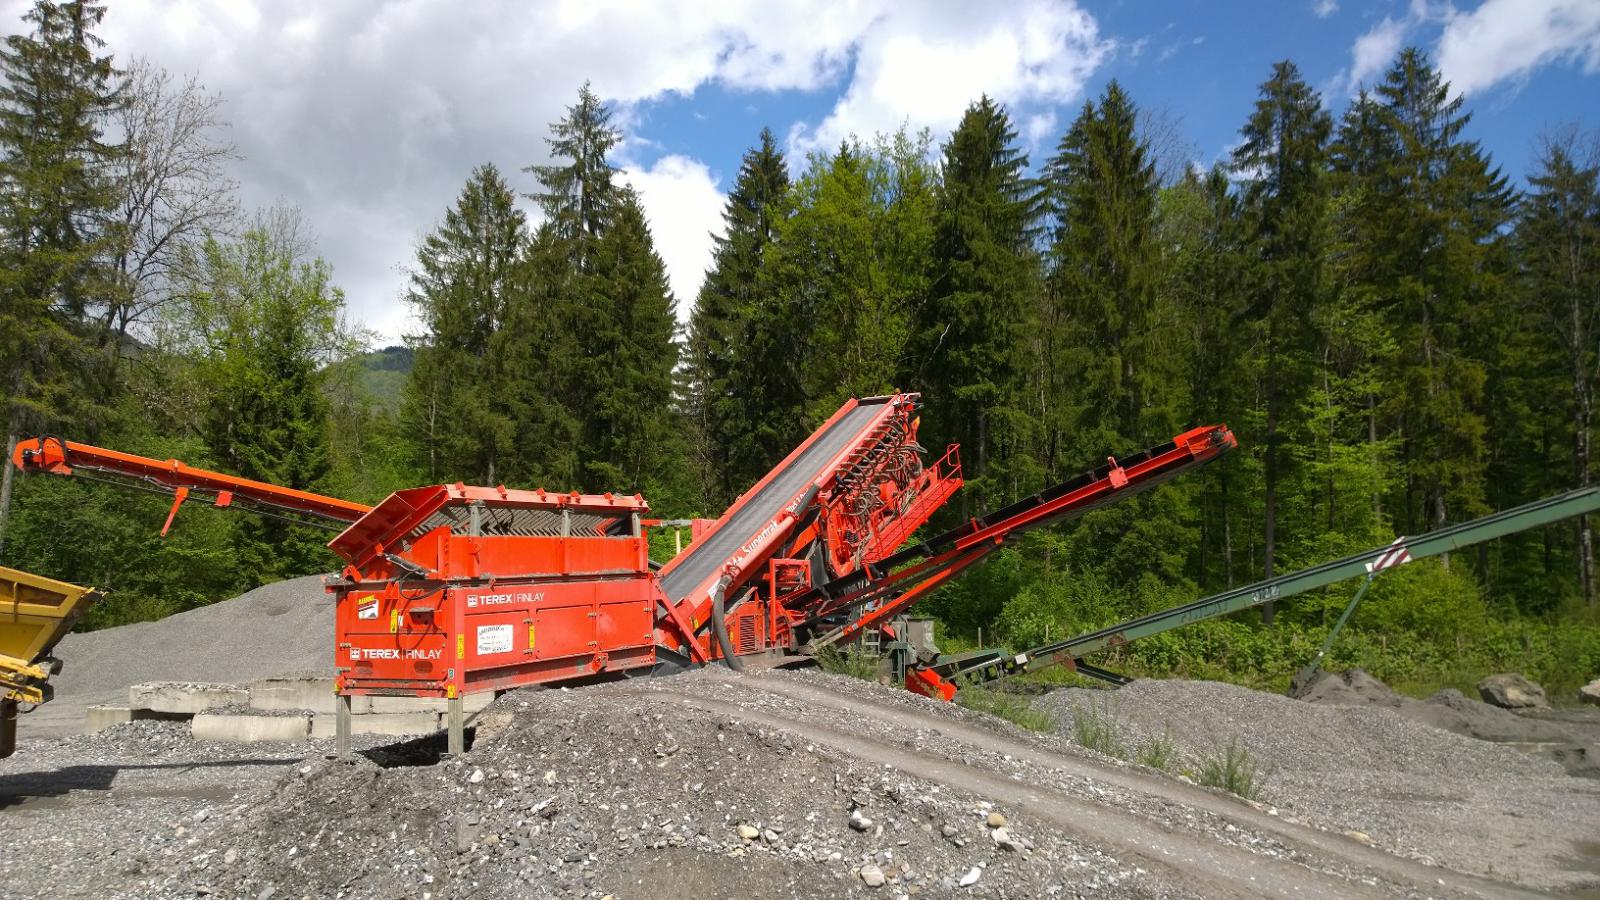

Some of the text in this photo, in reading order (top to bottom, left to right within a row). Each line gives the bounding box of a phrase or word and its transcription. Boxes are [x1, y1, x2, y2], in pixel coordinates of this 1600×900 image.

[479, 592, 544, 605] TEREX FINLAY
[362, 648, 442, 659] TEREX FINLAY
